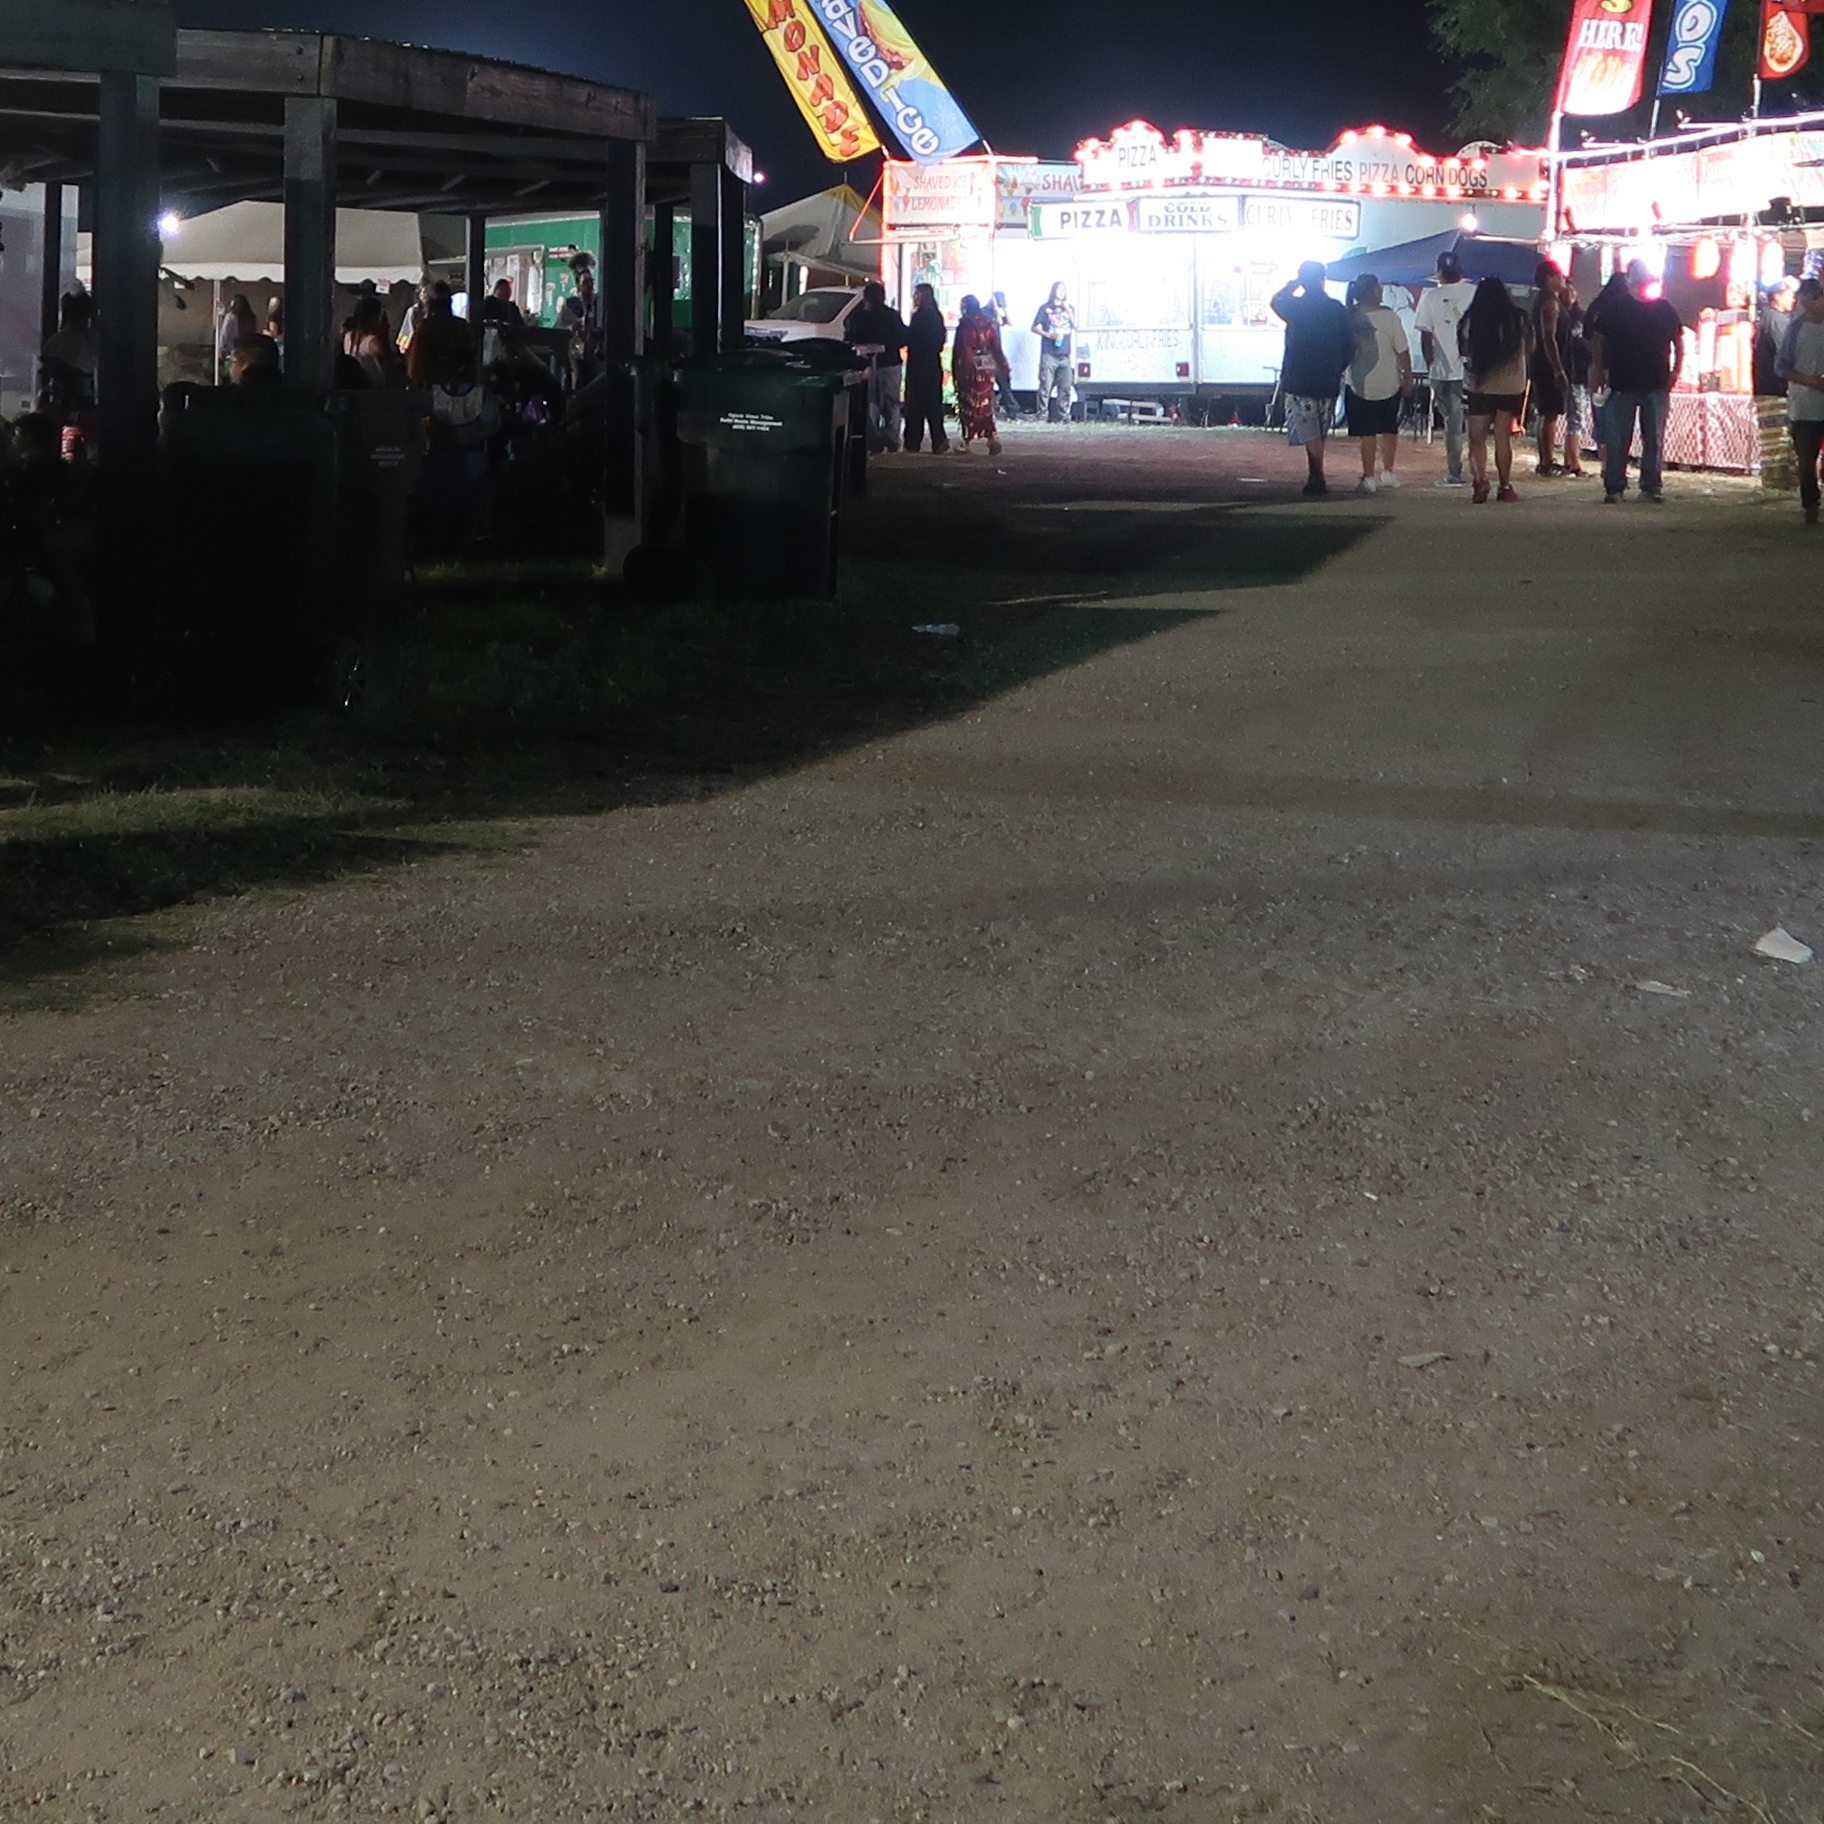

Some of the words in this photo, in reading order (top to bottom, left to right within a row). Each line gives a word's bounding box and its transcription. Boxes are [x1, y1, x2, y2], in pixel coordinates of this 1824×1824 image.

[1118, 144, 1158, 168] PIZZA
[913, 175, 951, 190] SHAVED
[1261, 156, 1308, 179] CURLY
[1312, 157, 1353, 182] FRIES
[1359, 162, 1401, 183] PIZZA
[1405, 164, 1445, 185] CORN
[1448, 166, 1488, 188] DOGS
[1060, 208, 1122, 230] PIZZA
[1164, 202, 1211, 214] COLD
[1246, 204, 1292, 227] CURLY
[1311, 208, 1354, 231] FRIES
[1148, 214, 1228, 228] DRINKS
